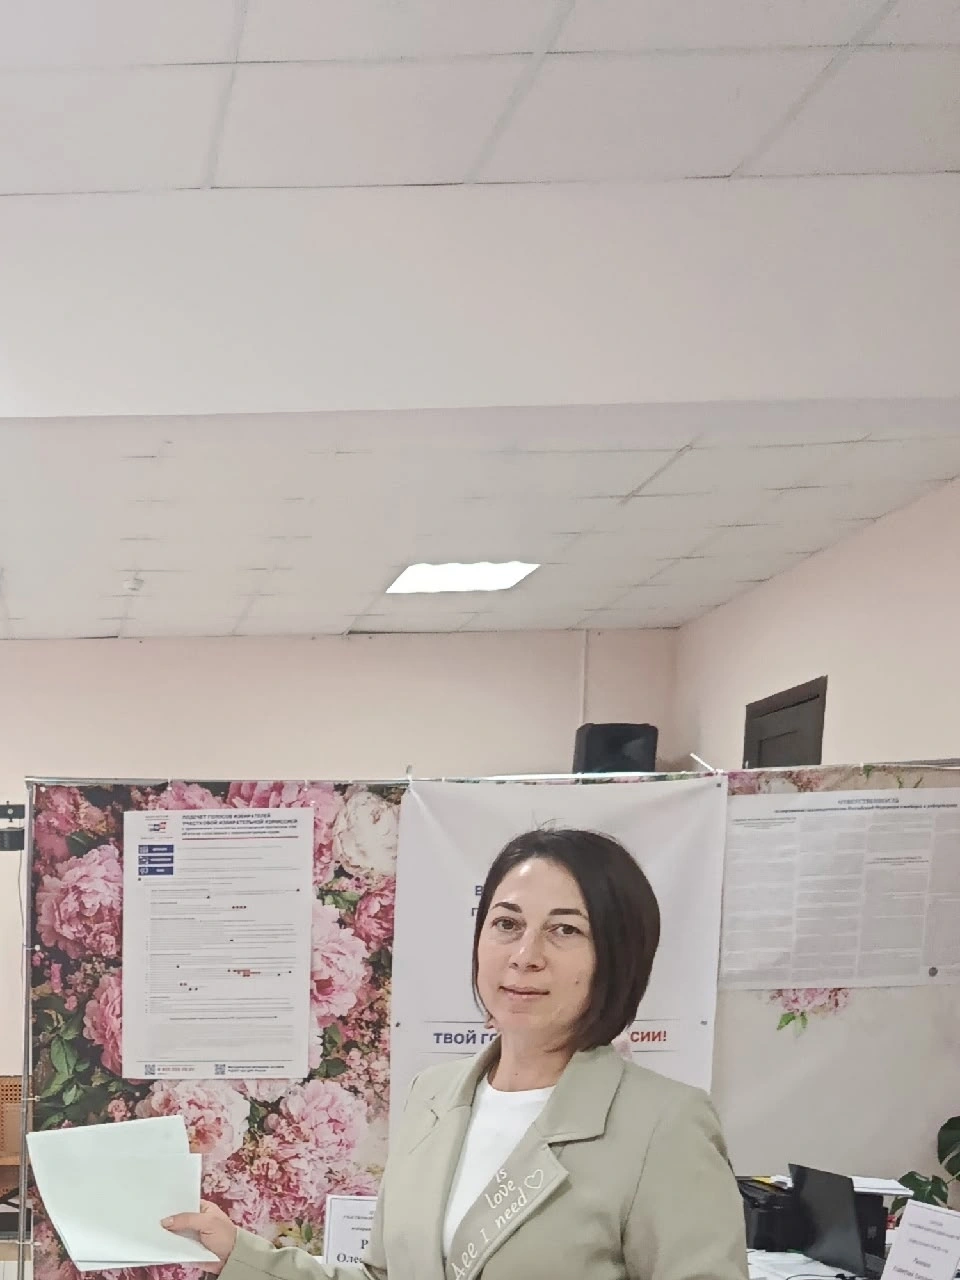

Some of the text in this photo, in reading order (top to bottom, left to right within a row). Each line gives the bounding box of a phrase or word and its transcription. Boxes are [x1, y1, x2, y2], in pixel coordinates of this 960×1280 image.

[433, 1030, 476, 1044] ТВОЙ
[630, 1031, 667, 1042] СИИ!
[485, 1180, 516, 1208] love
[494, 1187, 527, 1228] need
